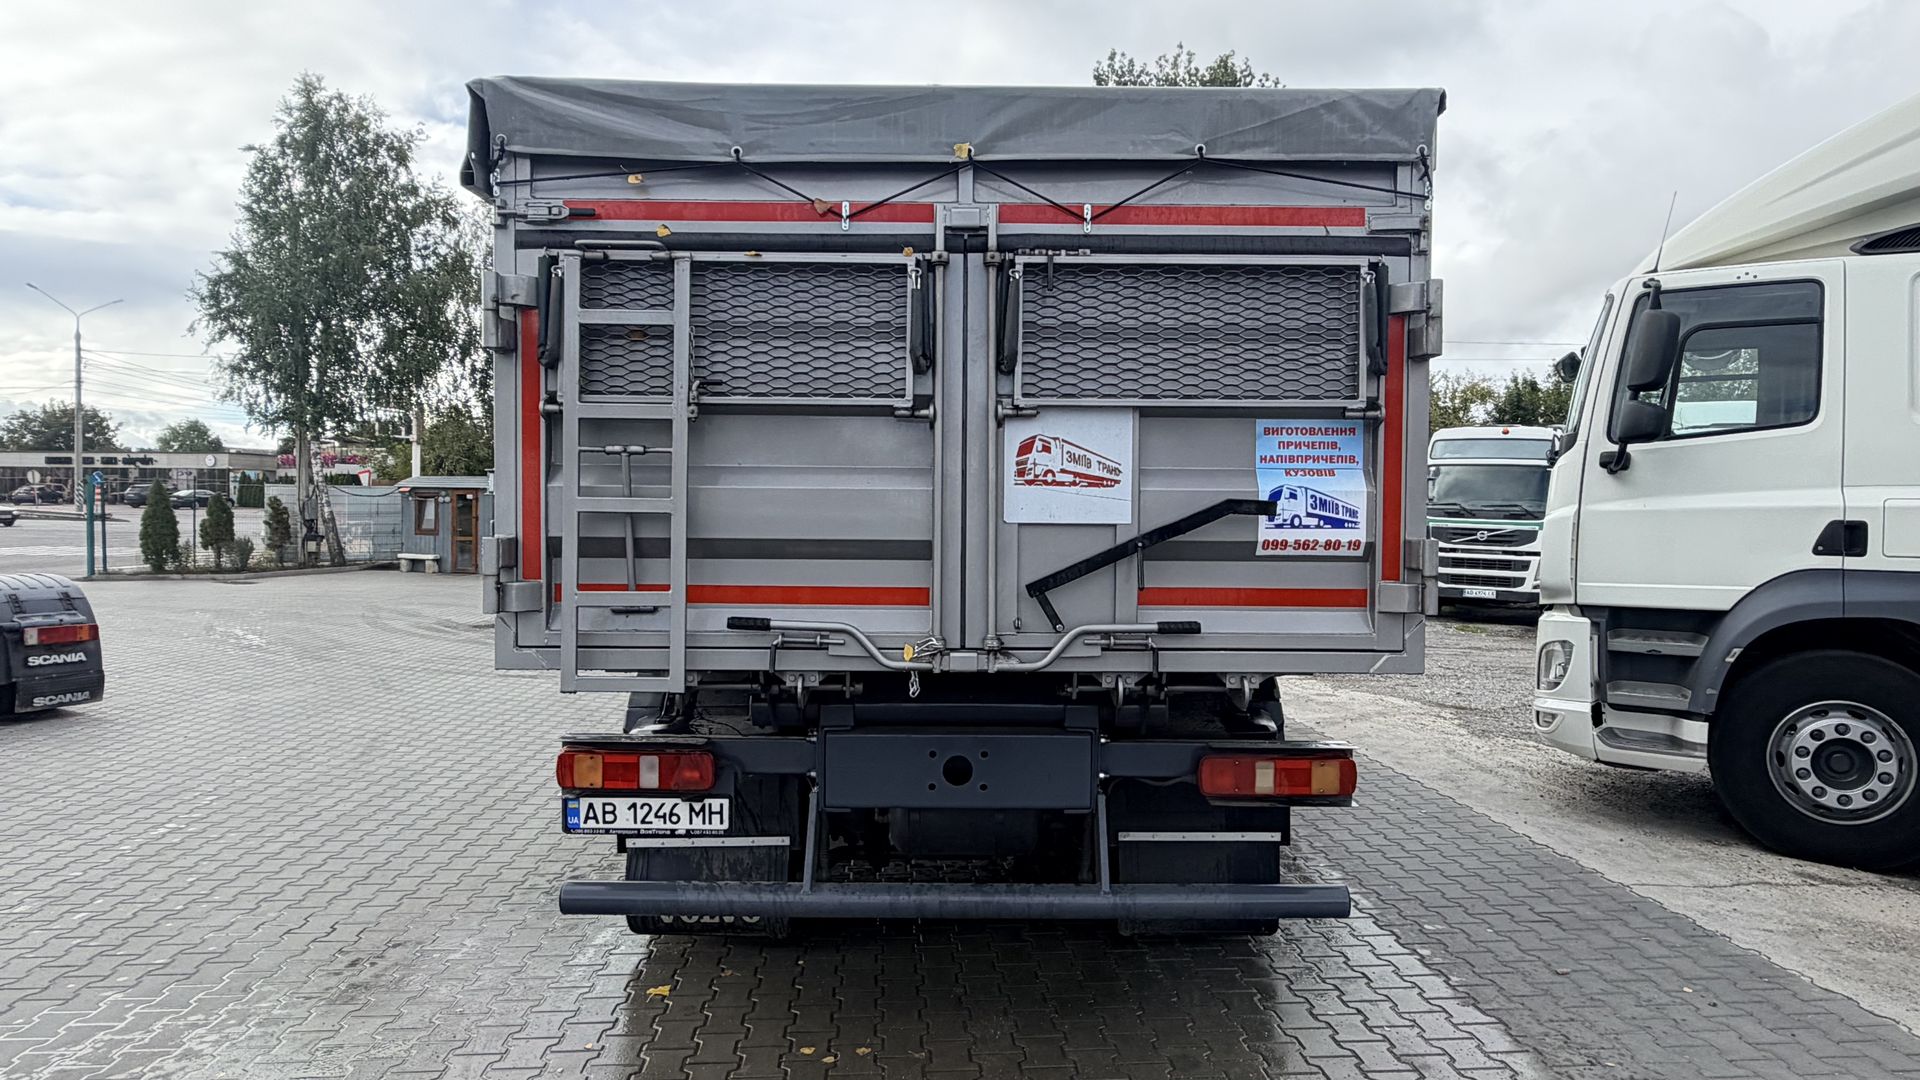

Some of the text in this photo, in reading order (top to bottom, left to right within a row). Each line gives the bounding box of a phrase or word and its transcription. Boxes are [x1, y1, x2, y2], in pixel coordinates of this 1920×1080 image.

[1263, 426, 1356, 437] ВИГОТОВЛЕННЯ
[1278, 440, 1342, 452] ПРИЧЕПІВ,
[1260, 454, 1360, 466] НАПІВПРИЧЕПІВ,
[1284, 468, 1336, 478] КУЗОВІВ
[1309, 494, 1341, 517] ЗМІЇВ
[1261, 538, 1362, 551] 099-562-80-19
[27, 652, 87, 666] SCANIA
[32, 691, 90, 706] SCANIA
[568, 816, 579, 824] UA
[583, 802, 724, 826] AB 1246 MH
